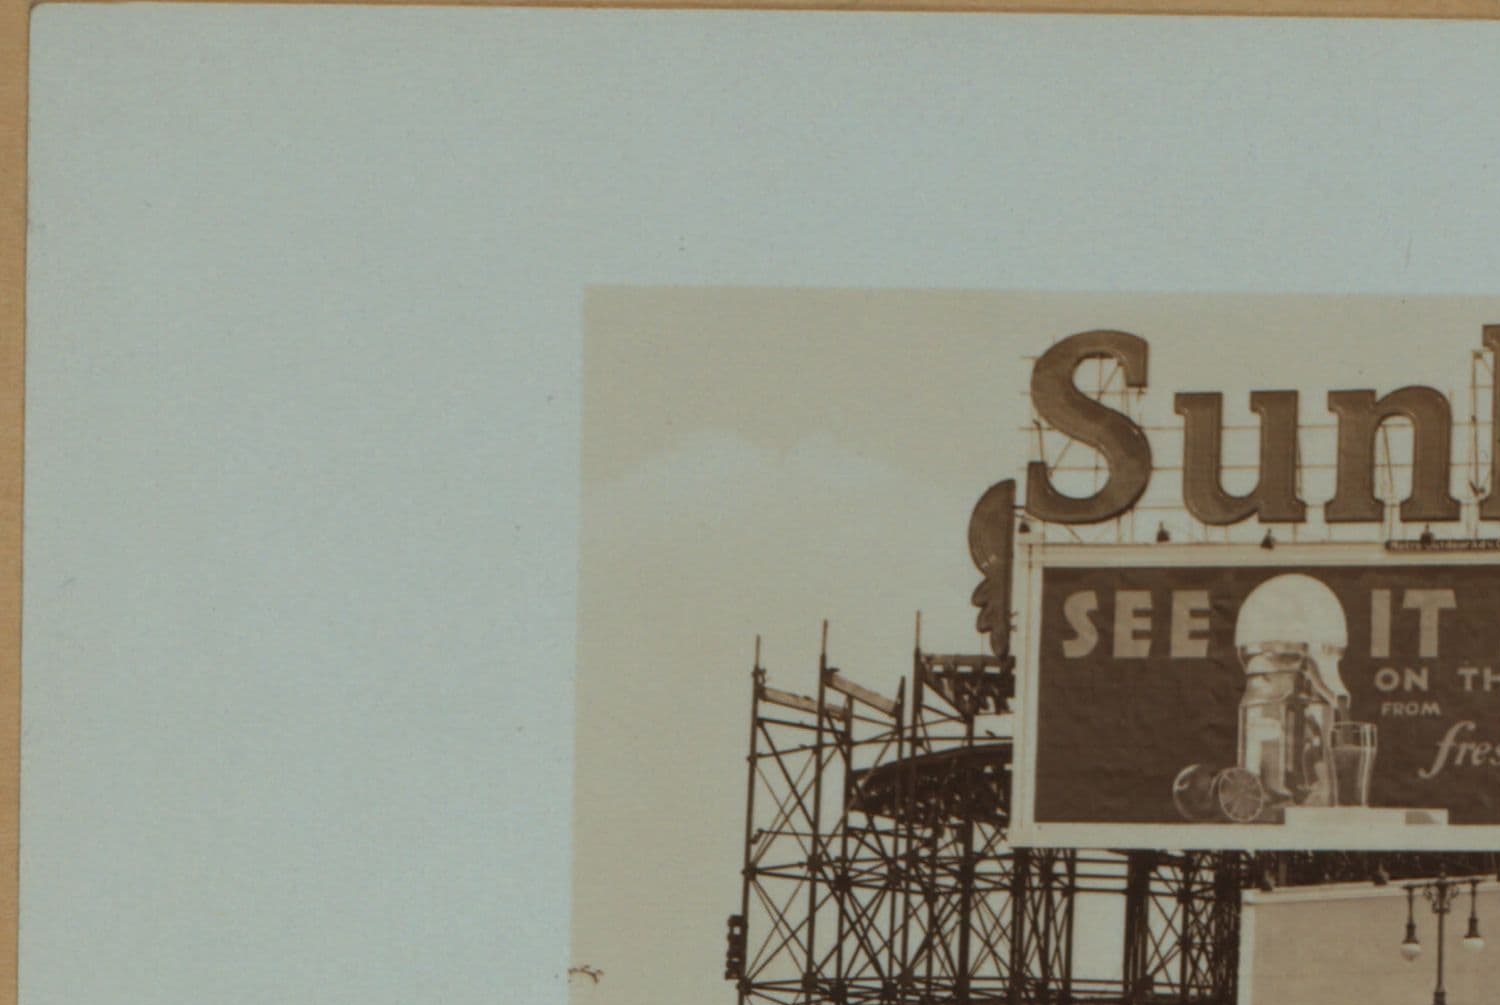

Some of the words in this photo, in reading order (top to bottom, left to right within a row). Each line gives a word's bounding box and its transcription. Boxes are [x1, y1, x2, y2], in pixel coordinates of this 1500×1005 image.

[1062, 590, 1212, 659] SEE
[1370, 588, 1456, 658] IT
[1375, 667, 1429, 692] ON
[1382, 702, 1441, 717] FROM
